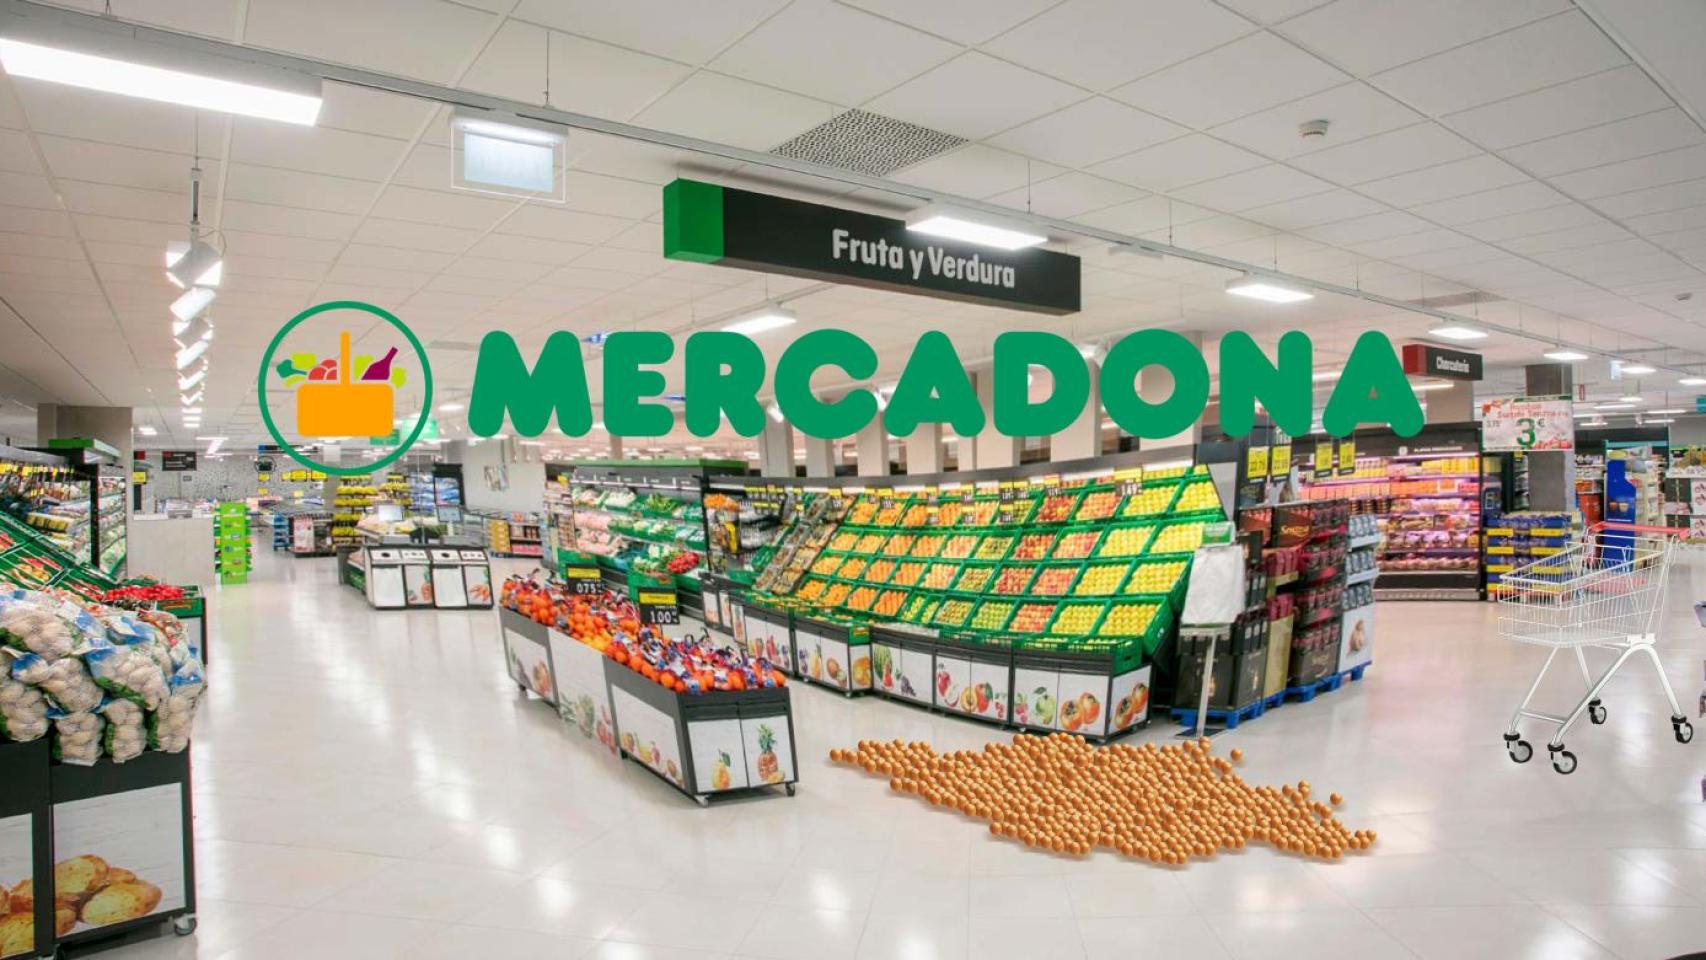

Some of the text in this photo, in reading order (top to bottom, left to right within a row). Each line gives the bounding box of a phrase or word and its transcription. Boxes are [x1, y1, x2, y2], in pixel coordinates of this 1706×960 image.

[832, 228, 1015, 289] Fruta y Verdura
